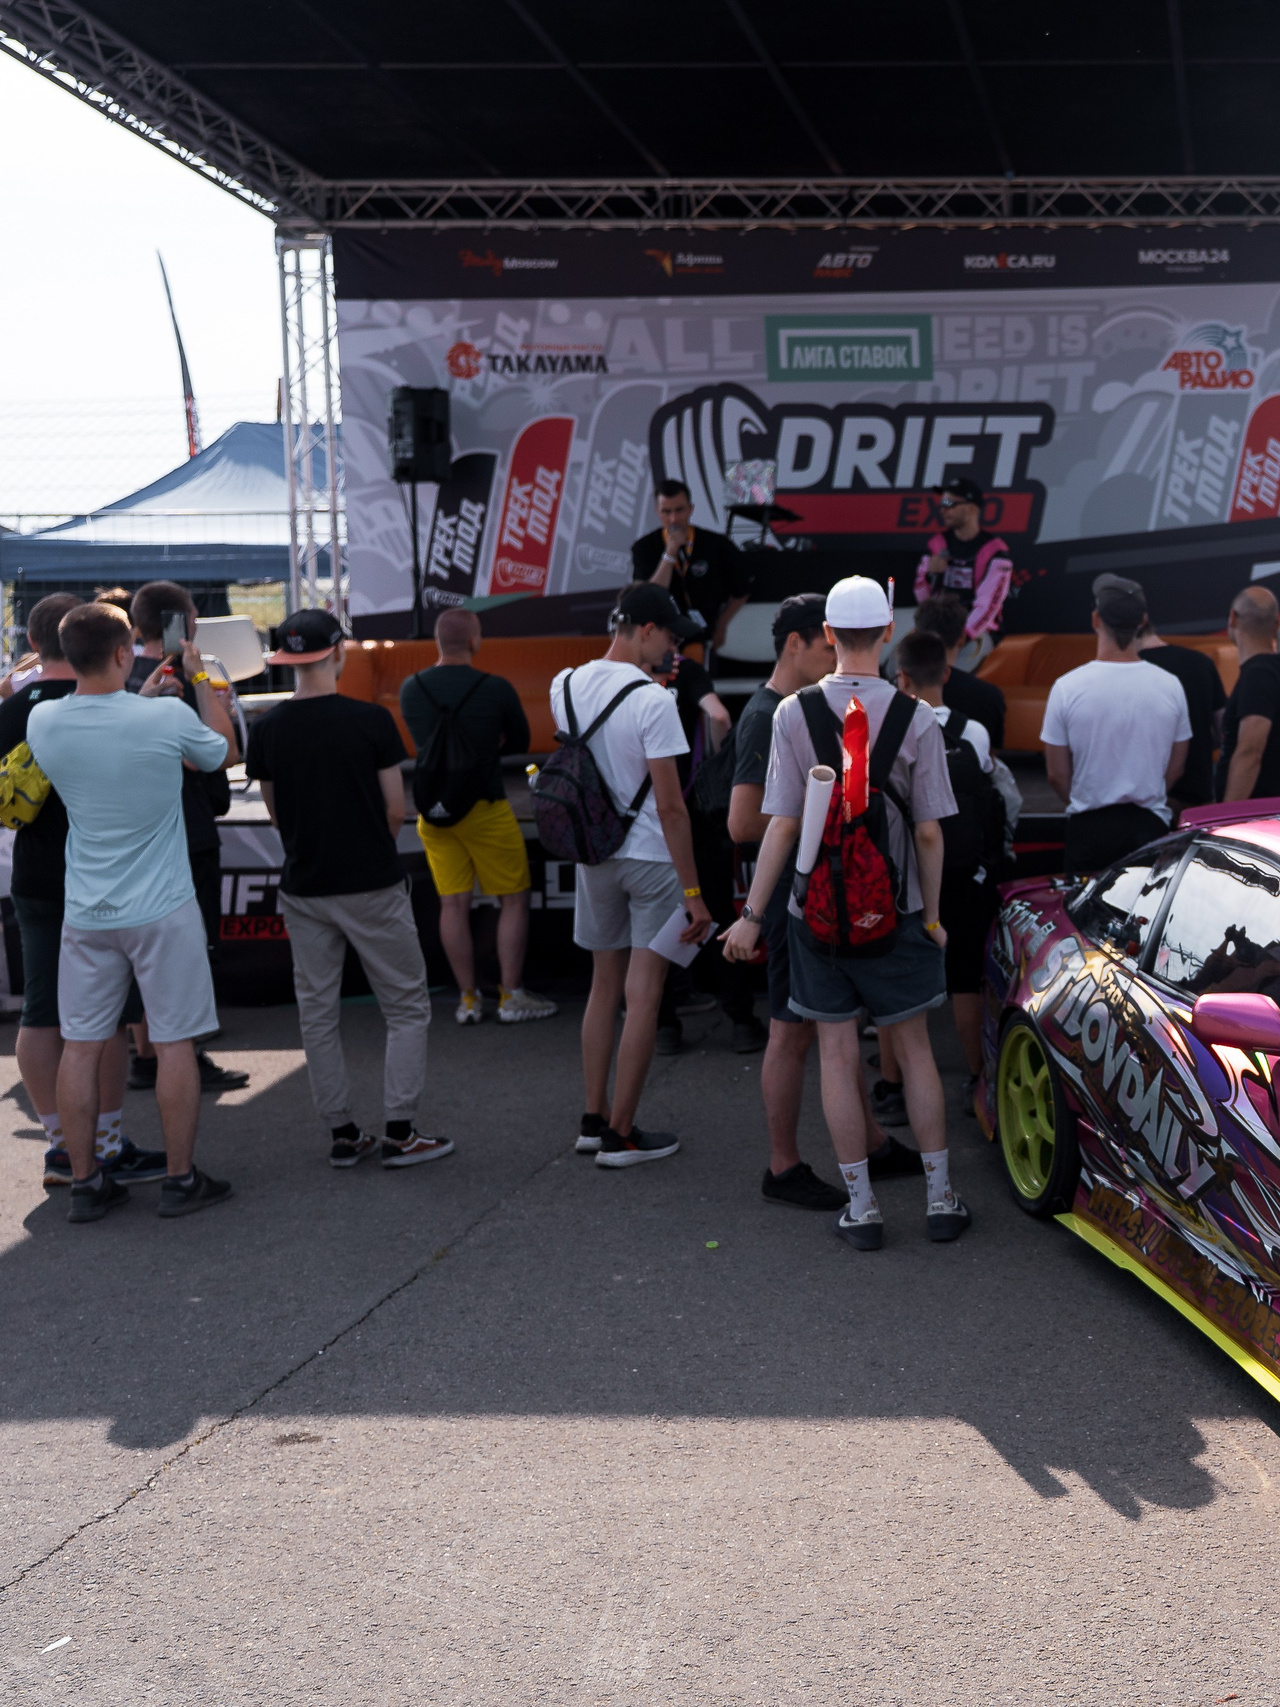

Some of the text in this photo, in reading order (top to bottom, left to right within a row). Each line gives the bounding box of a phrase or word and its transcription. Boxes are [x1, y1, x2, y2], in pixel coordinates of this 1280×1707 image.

[606, 317, 755, 373] ALL
[487, 354, 609, 374] TAKAYAMA
[792, 345, 908, 369] ЛИГА СТАВОК
[1161, 350, 1223, 371] АВТО
[1179, 368, 1256, 390] РАДИО
[773, 415, 1043, 489] DRIFT
[896, 497, 1006, 528] EXO
[223, 918, 284, 936] EXPO
